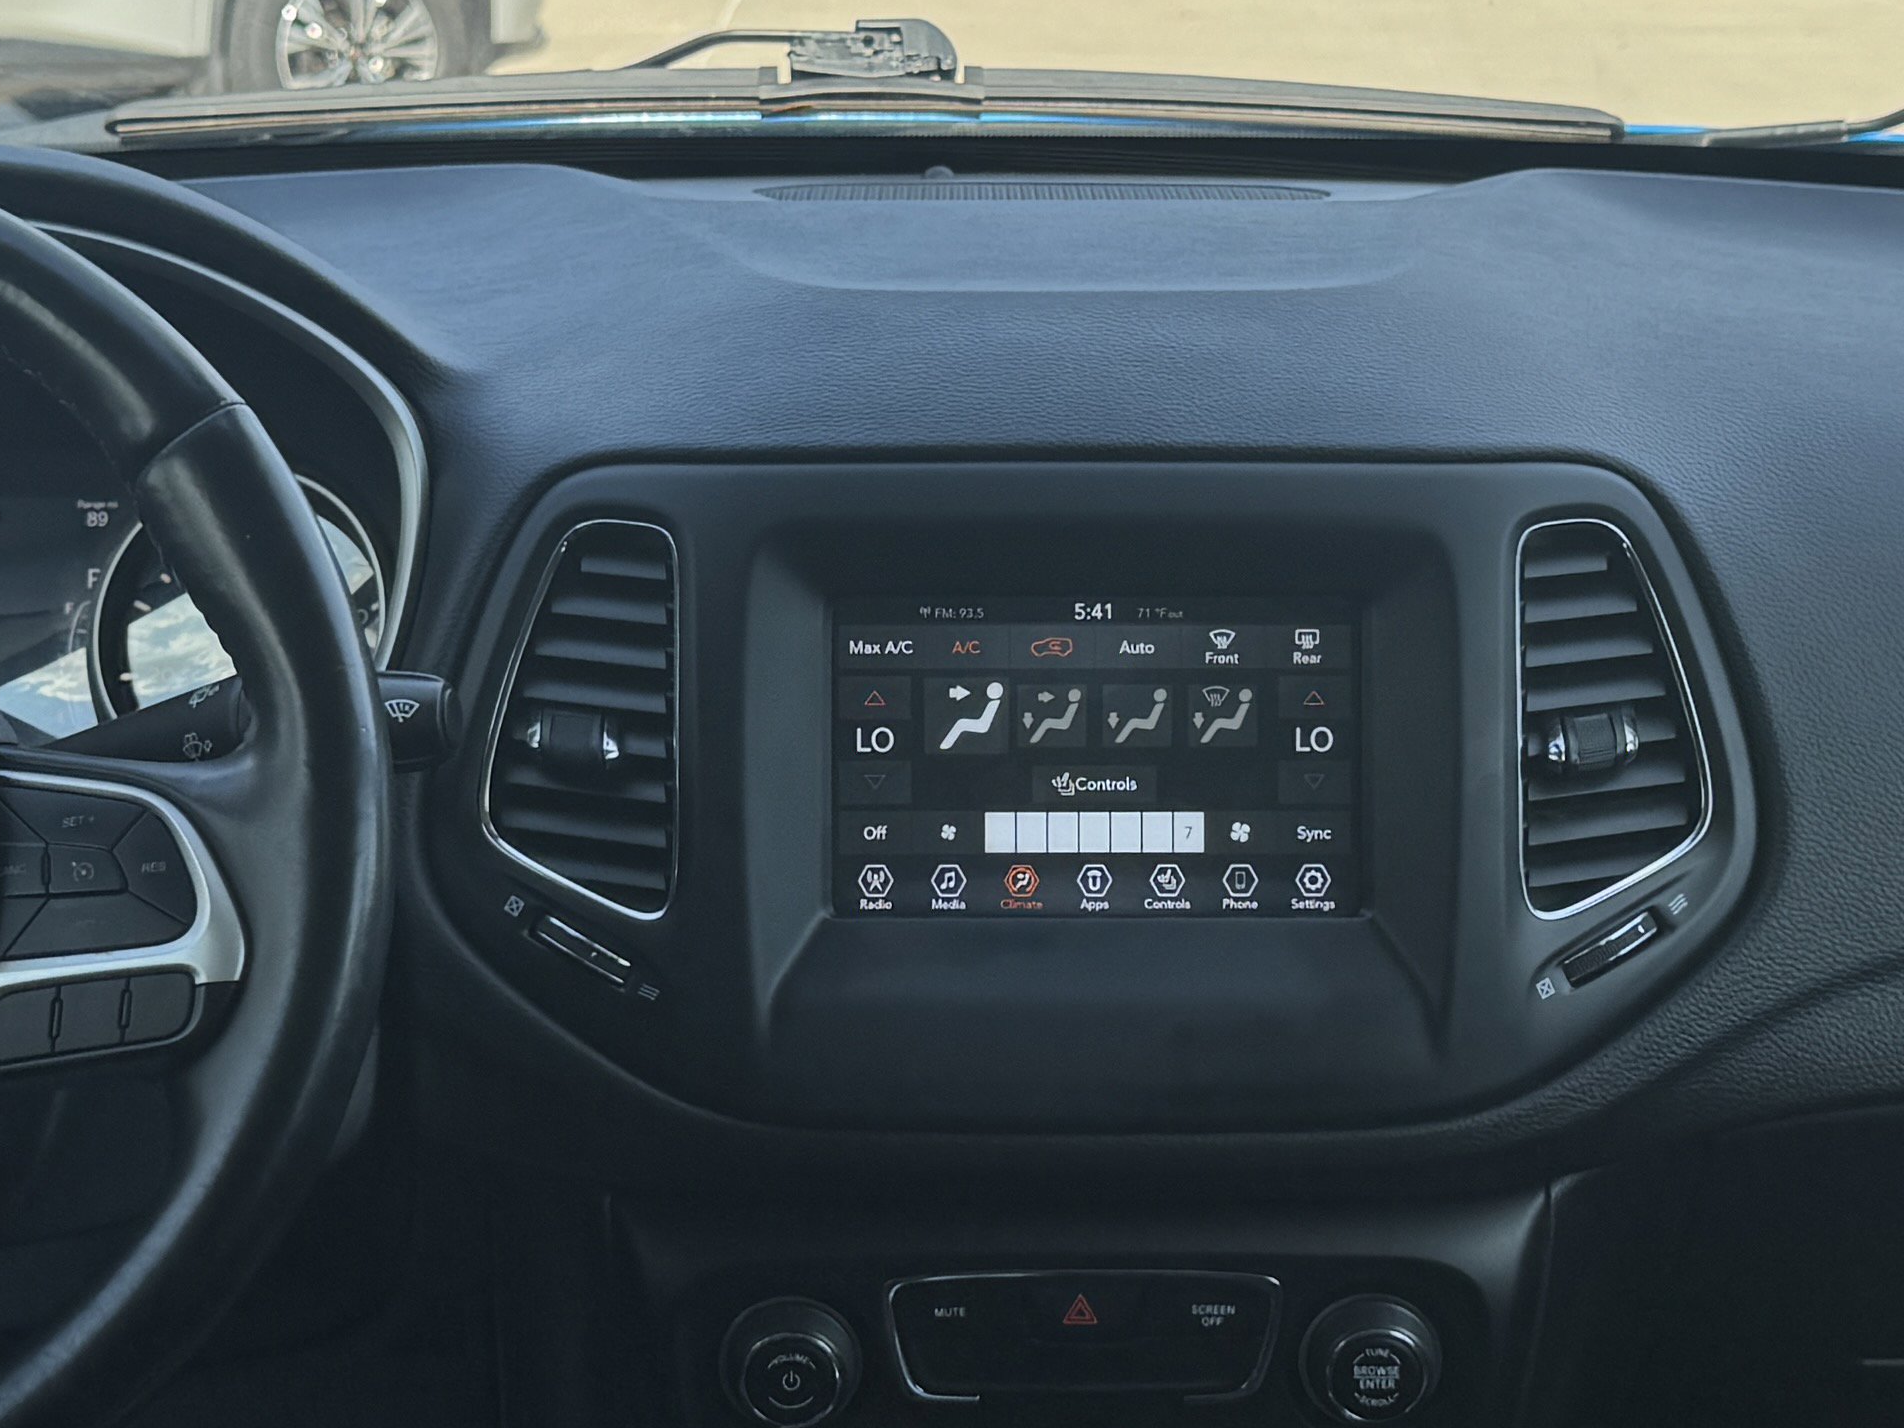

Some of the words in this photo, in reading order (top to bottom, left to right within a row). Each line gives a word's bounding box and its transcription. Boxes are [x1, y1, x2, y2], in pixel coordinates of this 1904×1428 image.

[87, 512, 109, 527] 89
[87, 568, 101, 589] F
[935, 607, 956, 619] FM:
[959, 607, 984, 619] 93.5
[1074, 603, 1113, 621] 5:41
[849, 640, 881, 655] Max
[884, 640, 914, 655] A/C
[952, 640, 981, 655] A/C
[1119, 640, 1155, 655] Auto
[1205, 651, 1239, 665] Front
[1293, 651, 1322, 665] Rear
[856, 727, 895, 753] LO
[1295, 727, 1334, 753] LO
[1075, 776, 1137, 792] Controls
[62, 816, 85, 828] SET
[863, 825, 887, 841] Off
[1184, 826, 1193, 840] 7
[1297, 825, 1331, 843] Sync
[141, 861, 167, 874] RES
[859, 898, 892, 911] Radio
[931, 898, 966, 911] Media
[1000, 898, 1043, 911] Climate
[1080, 898, 1109, 913] Apps
[1144, 898, 1191, 911] Controls
[1222, 898, 1258, 911] Phone
[1291, 898, 1335, 913] Settings
[934, 1307, 966, 1317] MUTE
[1191, 1304, 1236, 1315] SCREEN
[1201, 1316, 1225, 1326] OFF
[1353, 1365, 1400, 1376] BROWSE
[1359, 1378, 1396, 1390] ENTER
